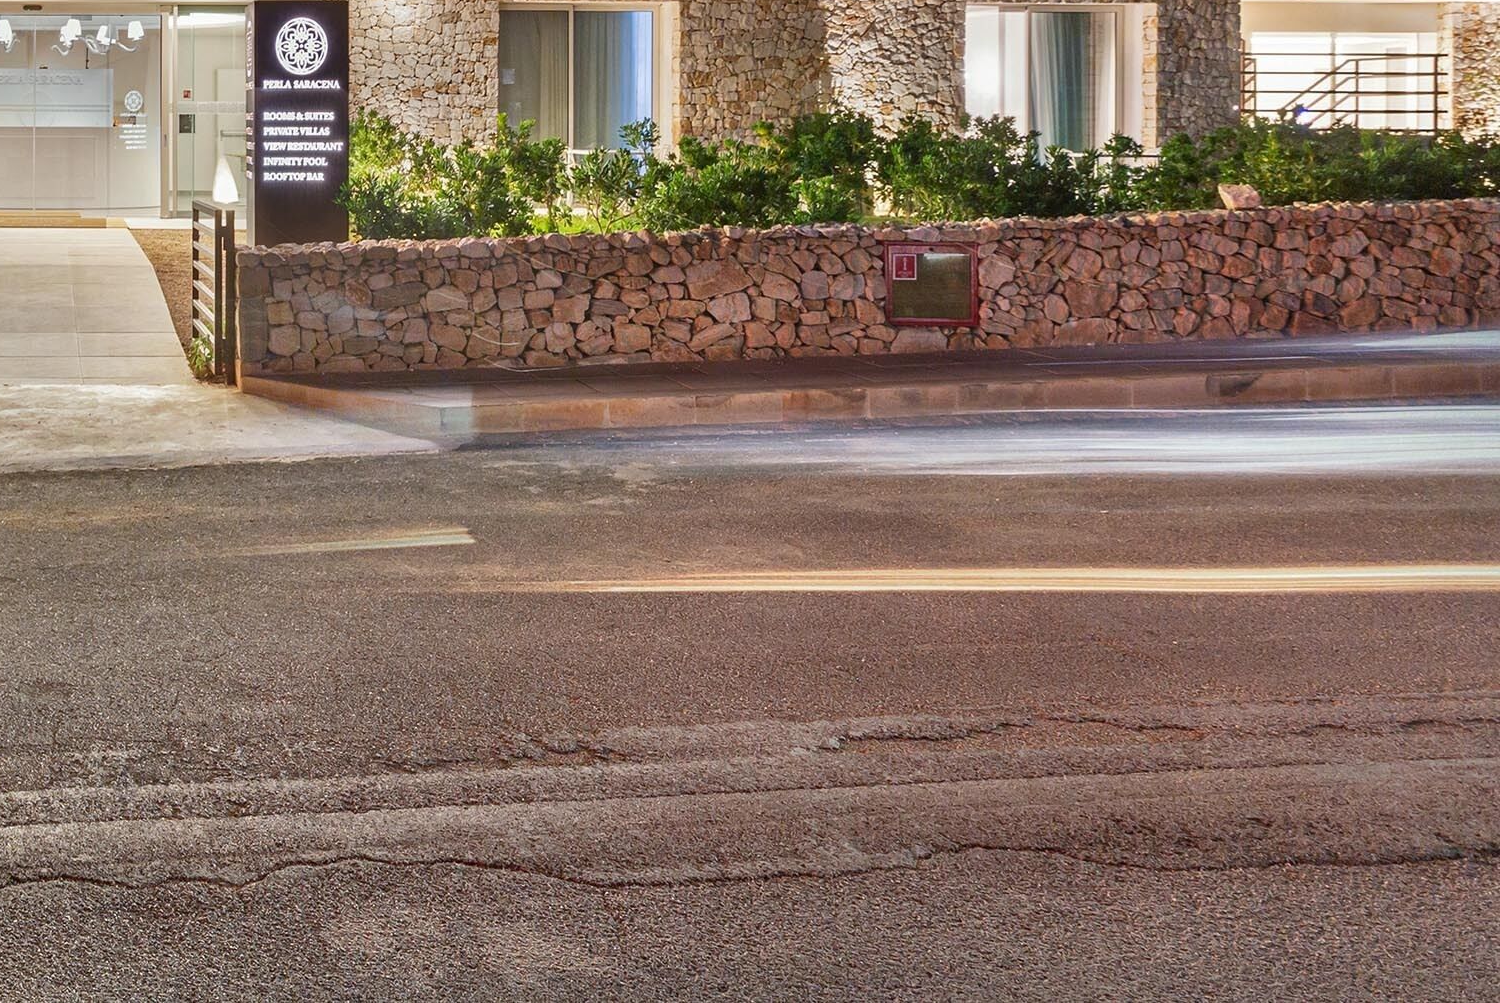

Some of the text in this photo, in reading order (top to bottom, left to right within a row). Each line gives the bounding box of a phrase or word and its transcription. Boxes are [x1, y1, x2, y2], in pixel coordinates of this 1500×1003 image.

[263, 80, 292, 90] PERLA
[293, 80, 340, 90] SARACENA
[263, 112, 295, 121] ROOMS
[296, 112, 304, 121] &
[304, 112, 335, 121] SUITES
[263, 127, 299, 136] PRIVATE
[300, 127, 330, 136] VILLAS
[263, 142, 287, 151] VIEW
[287, 142, 343, 151] RESTAURANT
[263, 157, 303, 166] INFINITY
[263, 172, 305, 181] ROOFTOP
[306, 172, 324, 181] BAR
